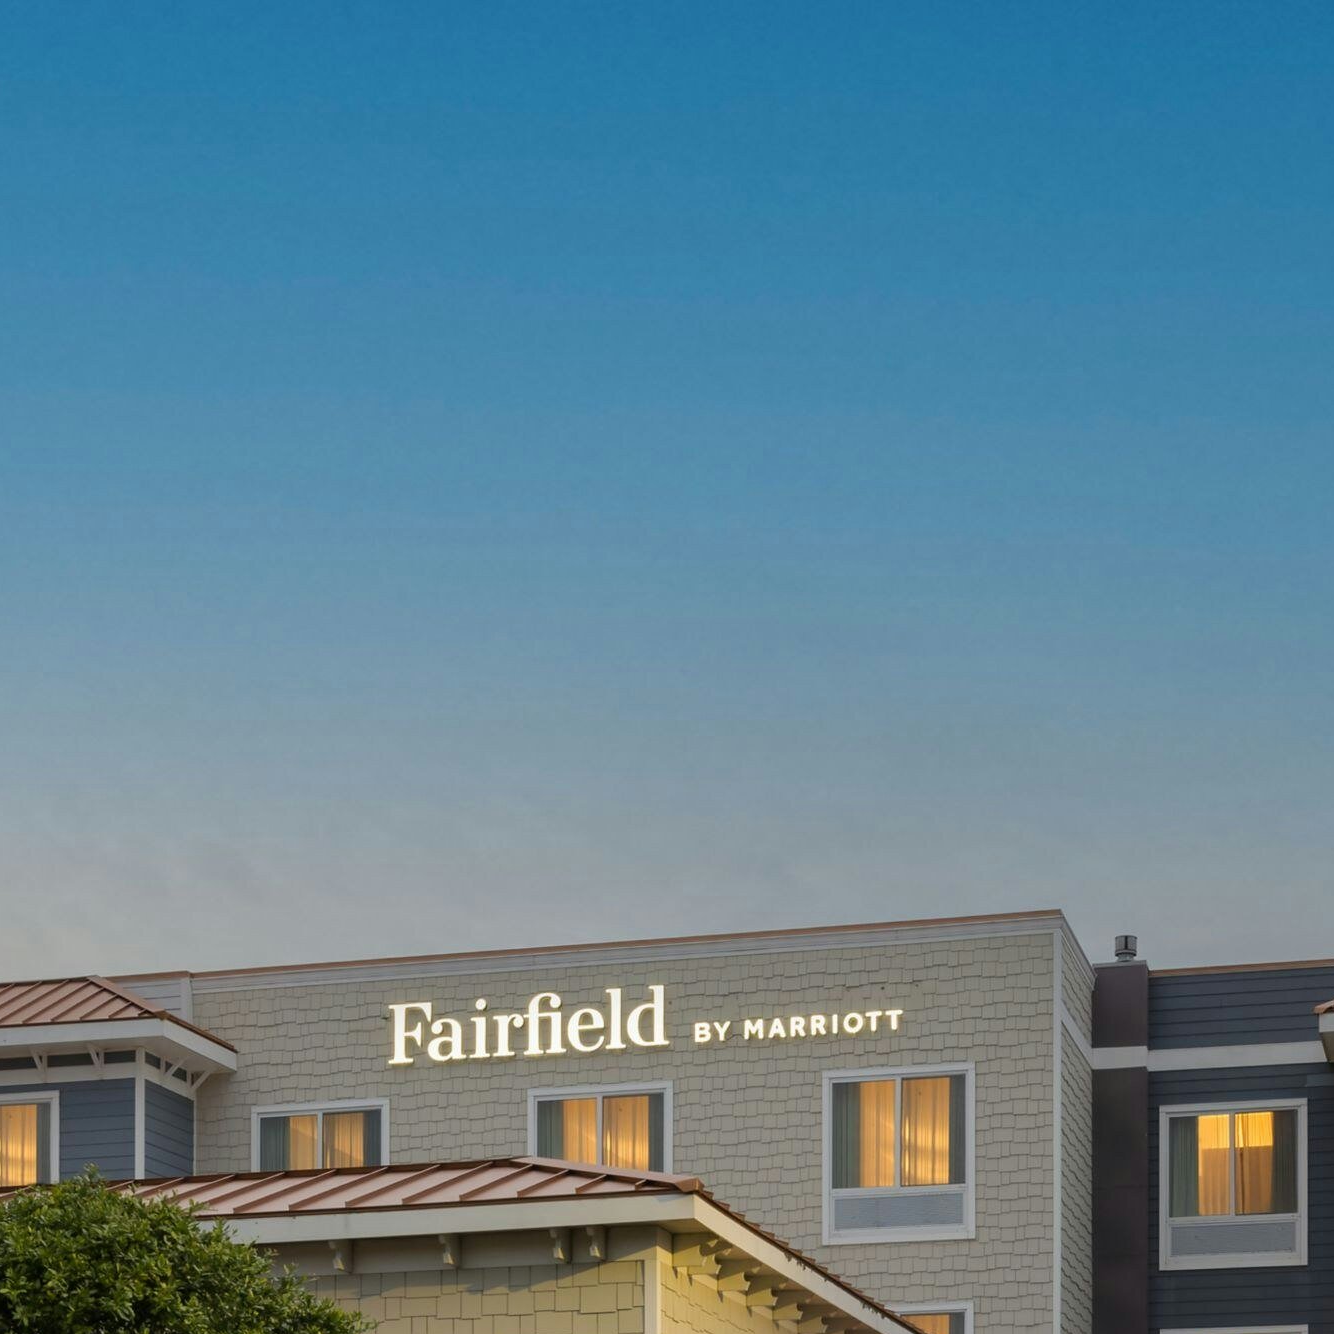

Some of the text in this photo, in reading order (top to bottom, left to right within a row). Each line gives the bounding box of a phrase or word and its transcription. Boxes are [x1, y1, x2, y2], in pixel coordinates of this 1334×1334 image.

[388, 984, 904, 1064] Fairfield BY MARRIOTT
